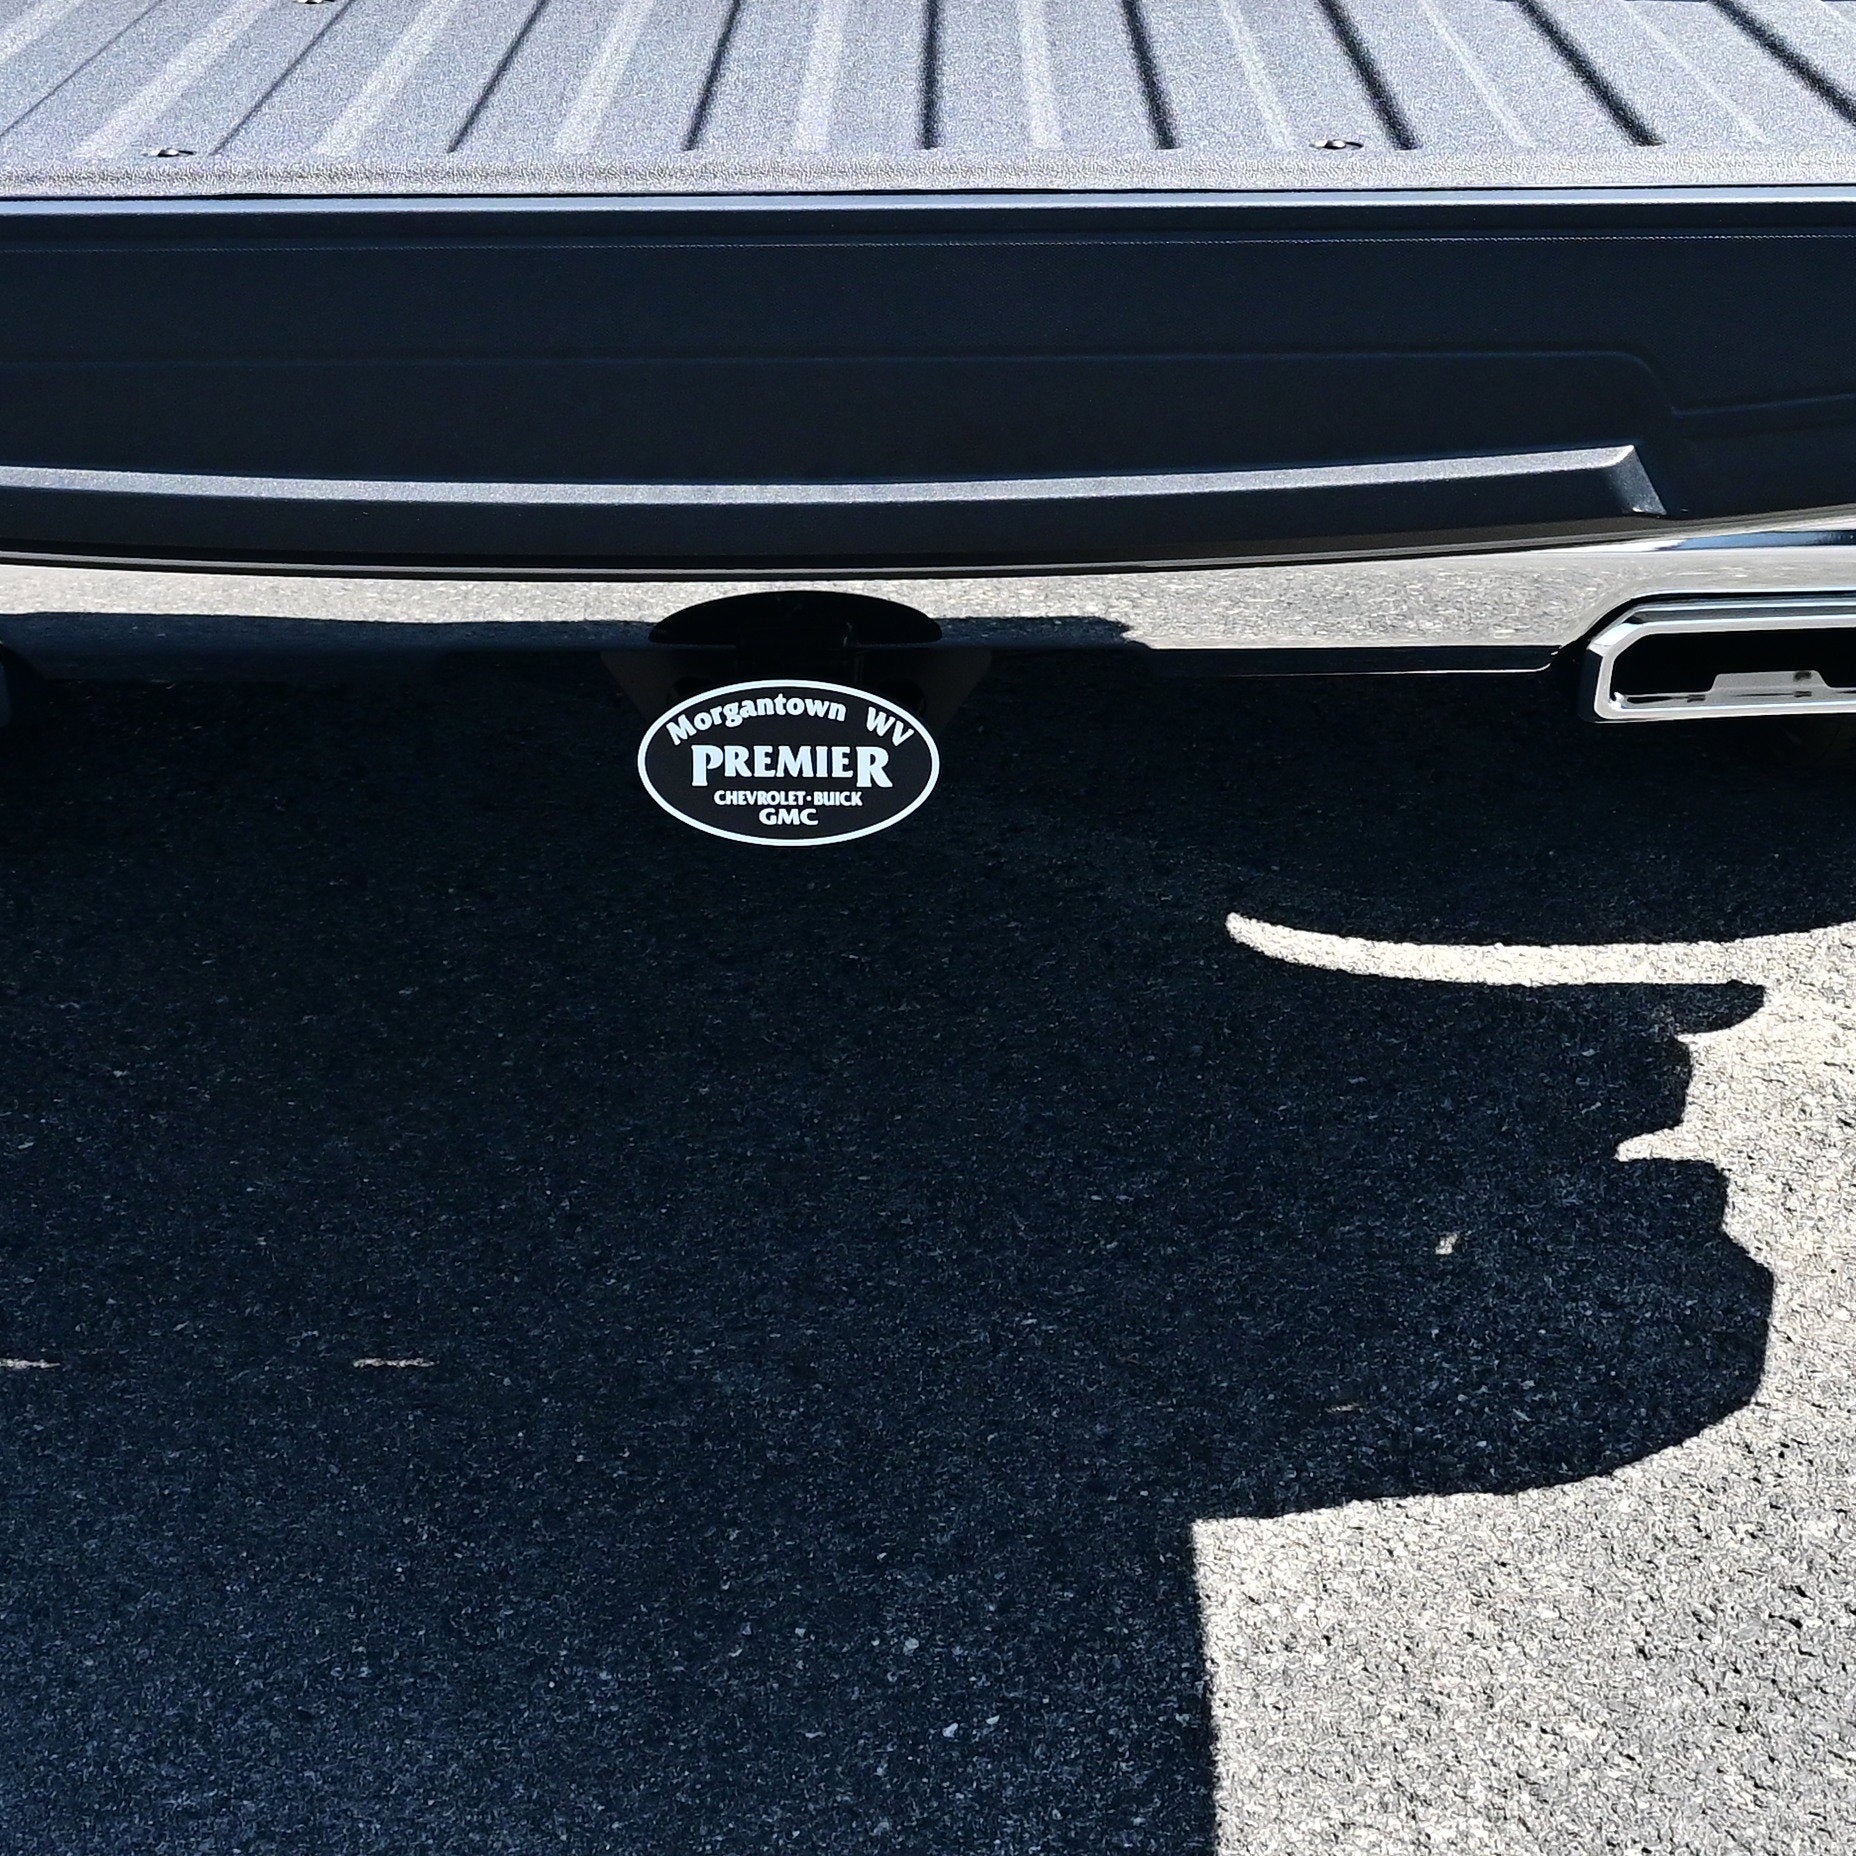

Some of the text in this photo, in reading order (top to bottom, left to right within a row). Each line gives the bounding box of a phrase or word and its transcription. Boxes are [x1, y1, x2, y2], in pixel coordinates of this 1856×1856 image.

[666, 693, 914, 747] Morgantown WV
[691, 744, 893, 788] PREMIER
[713, 791, 863, 807] CHEVROLET BUICK
[758, 808, 819, 826] GMC
